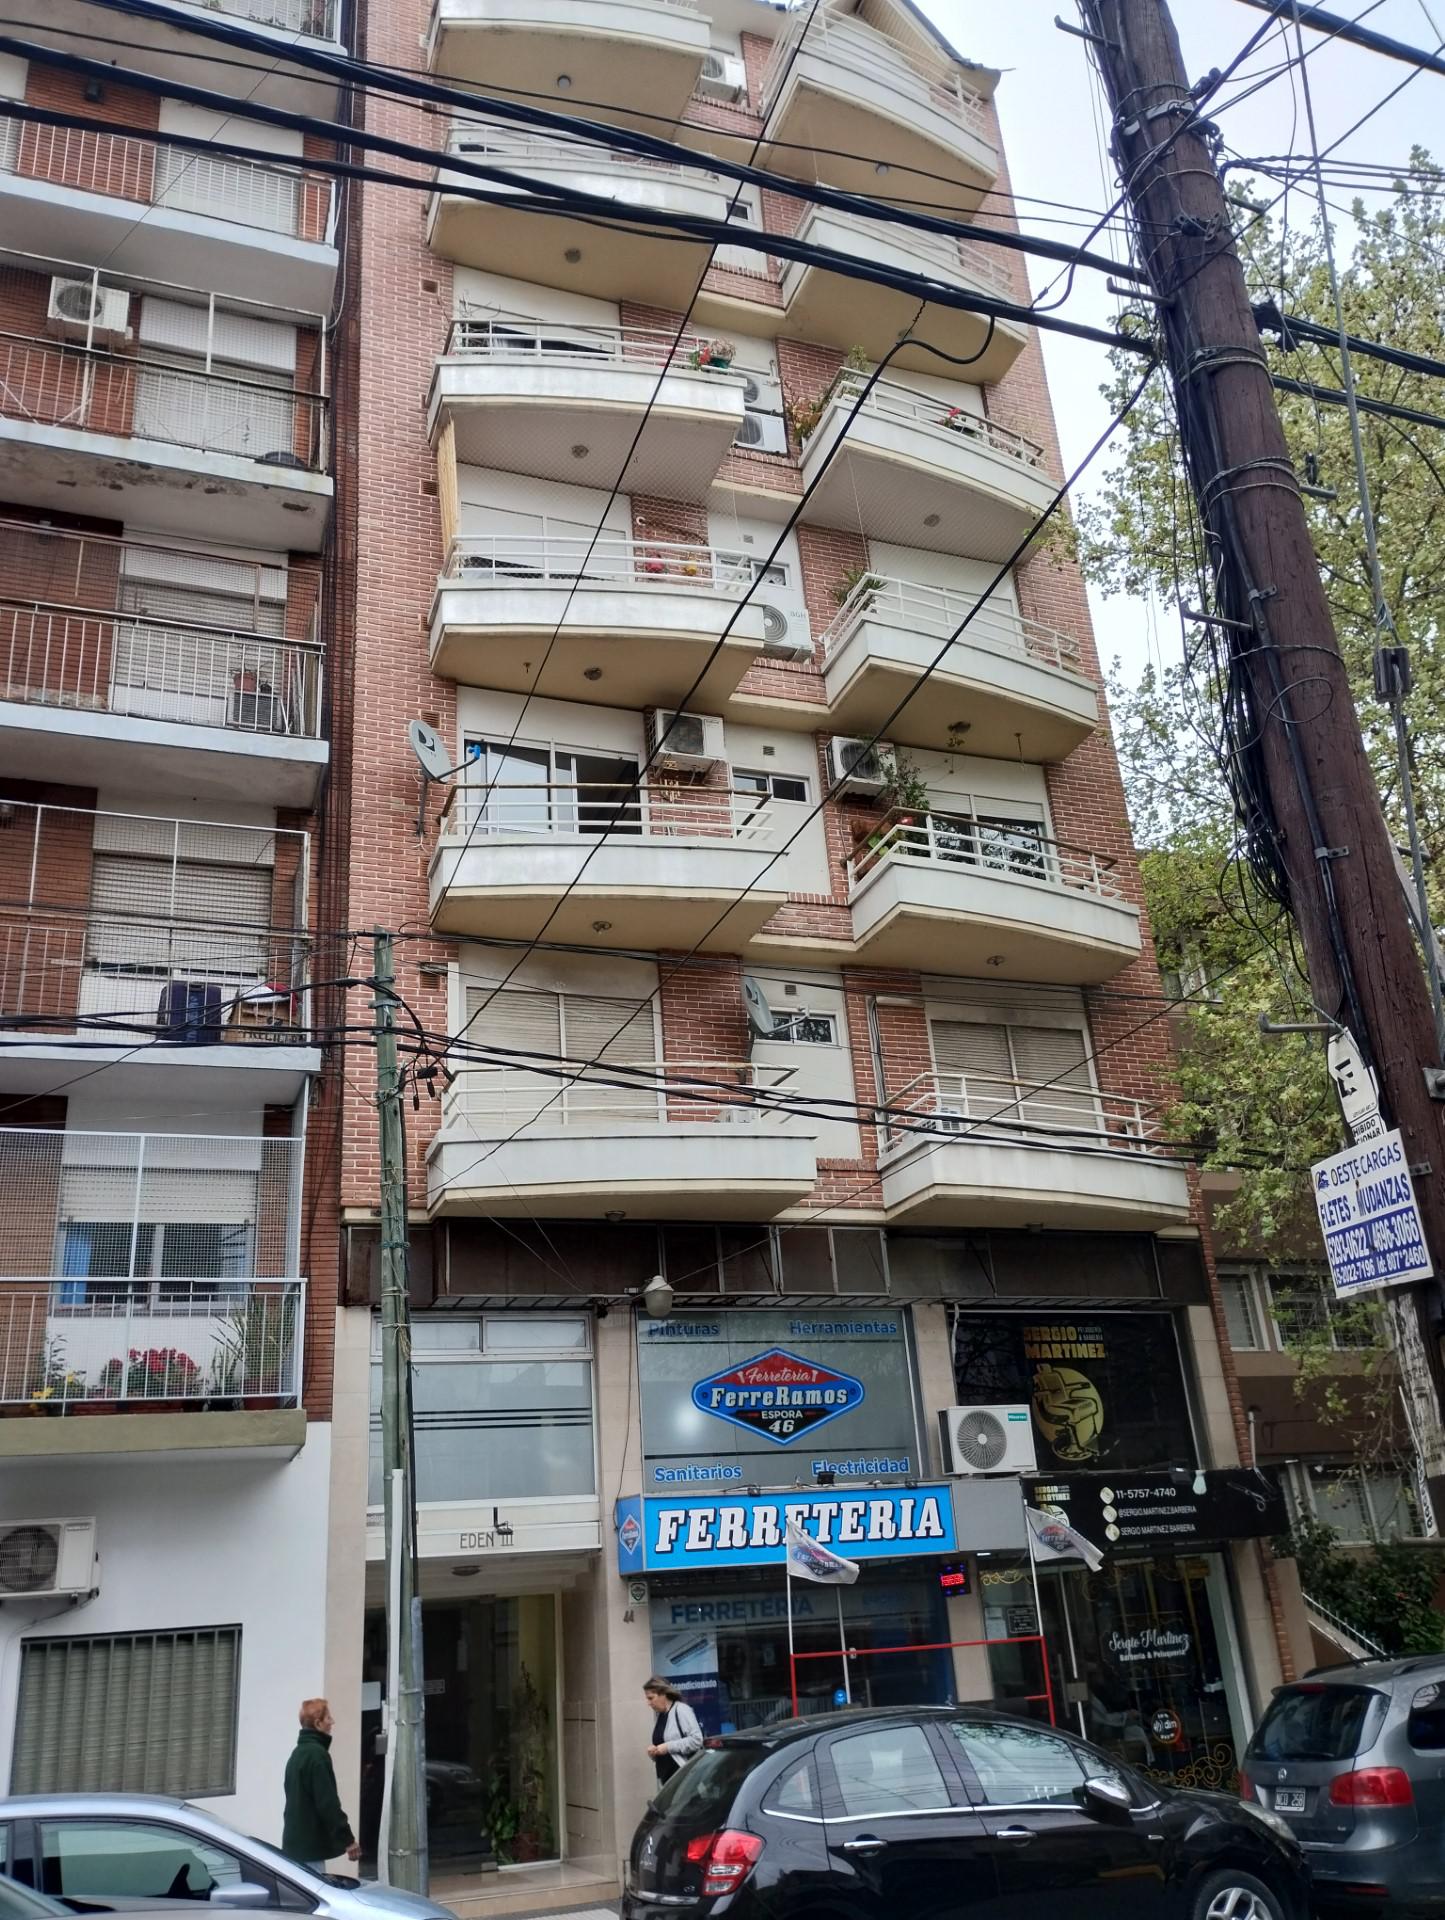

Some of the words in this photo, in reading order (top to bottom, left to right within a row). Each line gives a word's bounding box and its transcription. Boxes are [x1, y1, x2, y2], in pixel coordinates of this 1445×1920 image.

[1320, 1195, 1351, 1229] FLETES
[1356, 1172, 1411, 1216] MUDANZAS
[648, 1322, 720, 1337] Pinturas
[789, 1319, 897, 1336] Herramientas
[1023, 1326, 1078, 1341] SERGIO
[1024, 1343, 1105, 1359] MARTINEZ
[710, 1386, 848, 1408] FerreRamos
[761, 1410, 804, 1420] ESPORA
[768, 1420, 795, 1433] 46
[654, 1461, 743, 1483] Sanitarios
[811, 1457, 910, 1477] Electricidad
[1116, 1488, 1176, 1499] 11-5757-4740
[655, 1498, 944, 1552] FERRETERIA
[460, 1532, 494, 1549] EDEN
[623, 1610, 635, 1624] 44
[1108, 1631, 1140, 1656] Sergio
